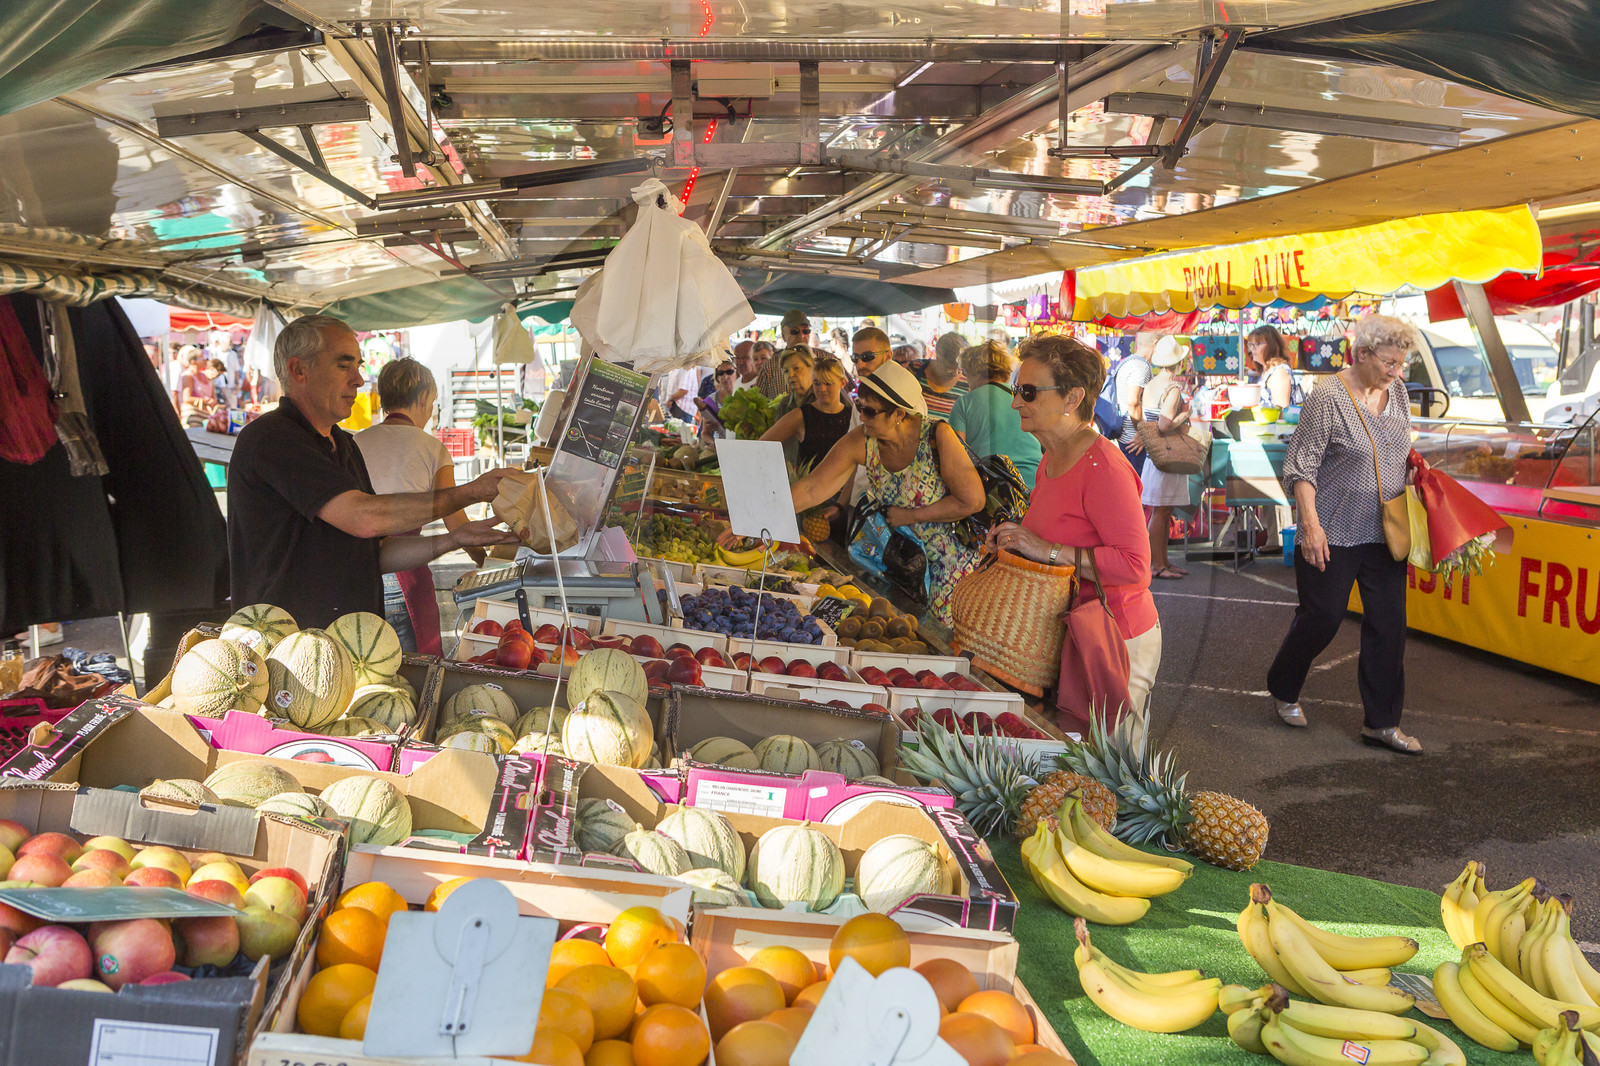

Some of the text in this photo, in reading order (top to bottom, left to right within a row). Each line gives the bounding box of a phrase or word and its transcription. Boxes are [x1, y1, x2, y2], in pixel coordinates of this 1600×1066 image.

[1254, 250, 1310, 293] OLIVE
[1517, 556, 1600, 635] FRU
[538, 810, 570, 847] Charnel
